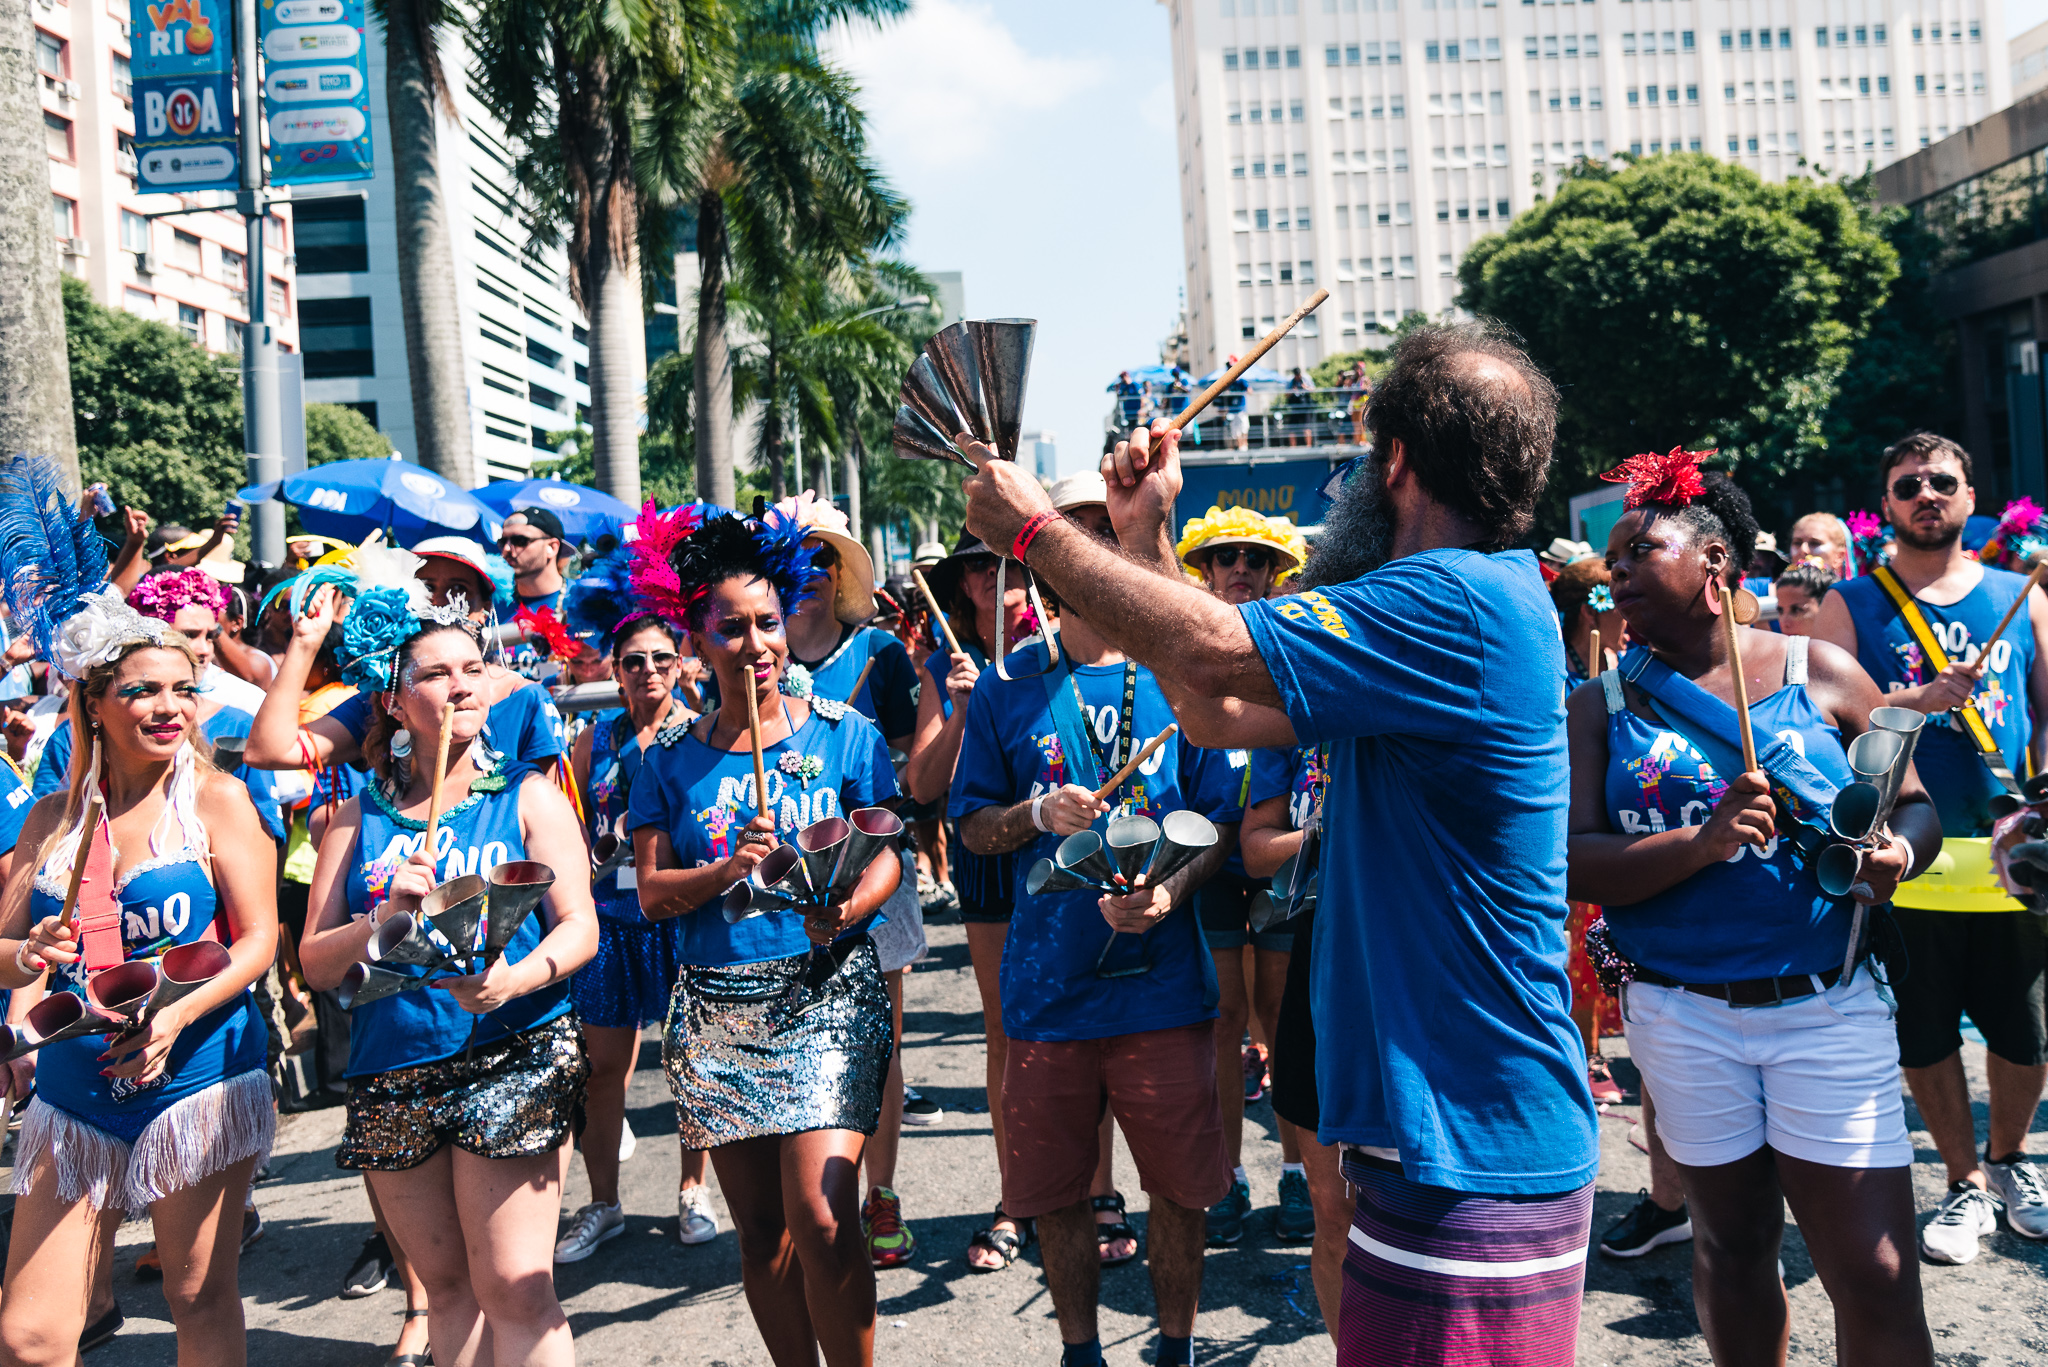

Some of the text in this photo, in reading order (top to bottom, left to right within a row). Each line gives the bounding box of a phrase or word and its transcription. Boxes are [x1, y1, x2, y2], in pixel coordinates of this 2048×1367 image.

[144, 87, 222, 137] BOA
[1217, 484, 1295, 513] MONO
[779, 786, 838, 836] NO
[125, 891, 191, 938] NO
